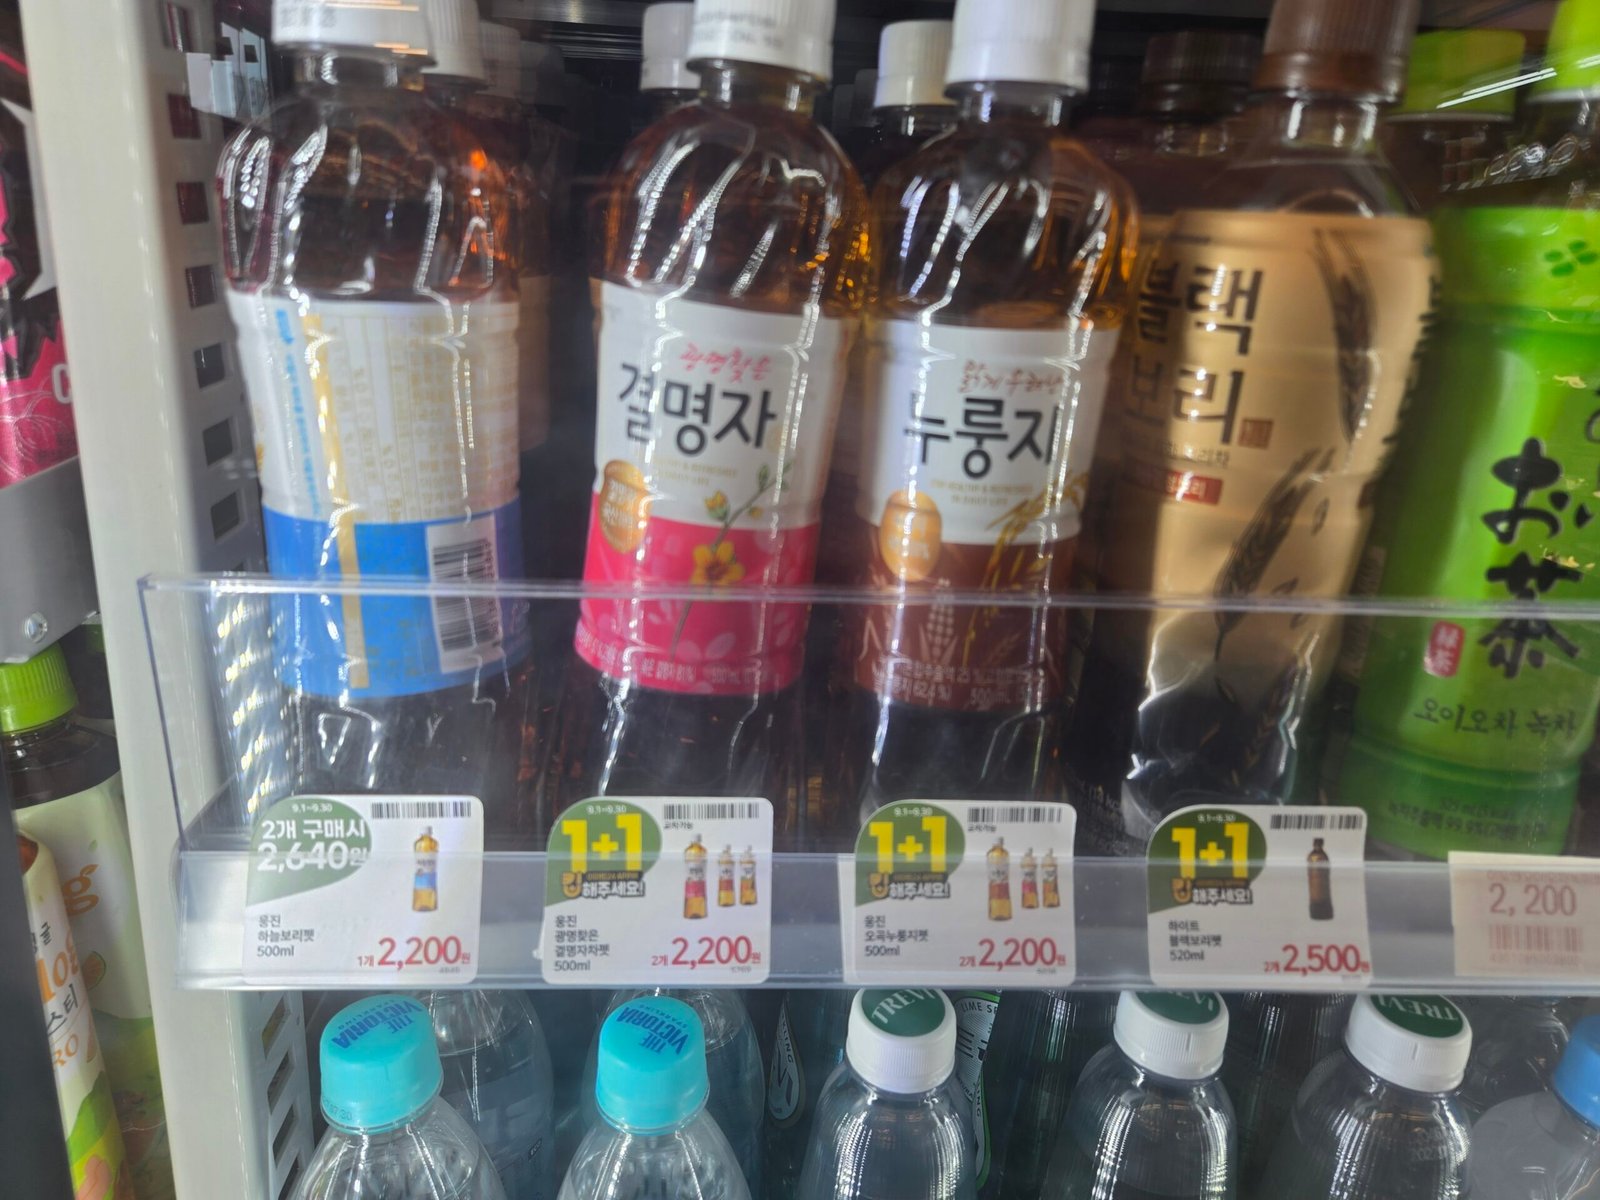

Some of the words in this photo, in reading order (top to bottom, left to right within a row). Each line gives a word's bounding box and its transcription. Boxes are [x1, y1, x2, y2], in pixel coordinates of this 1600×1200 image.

[618, 362, 778, 456] 결명자
[903, 391, 1062, 480] 누룽지
[1414, 697, 1517, 739] 오이오차
[1526, 710, 1577, 738] 녹차
[261, 819, 297, 840] 2개
[303, 818, 366, 840] 구매시
[562, 813, 643, 874] 1+1
[869, 816, 948, 875] 1+1
[1171, 822, 1249, 879] 1+1
[1488, 882, 1578, 917] 2,200
[258, 914, 281, 928] 웅진
[555, 914, 577, 928] 웅진
[864, 914, 887, 928] 웅진
[1168, 920, 1200, 933] 하이트
[257, 928, 315, 943] 하늘보리펫
[555, 929, 600, 943] 광명찾은
[864, 929, 929, 943] 오곡누룽지펫
[257, 945, 295, 957] 500ml
[555, 944, 611, 957] 결명자차펫
[864, 945, 900, 957] 500ml
[1169, 949, 1205, 961] 520ml
[358, 955, 374, 968] 1개
[554, 959, 591, 972] 500ml
[651, 955, 669, 967] 2개
[959, 956, 976, 969] 2개
[1264, 961, 1281, 974] 2개
[961, 1001, 983, 1013] LIME
[331, 1000, 424, 1050] VICTORIA
[385, 1014, 415, 1035] THE
[615, 1006, 689, 1056] VICTORIA
[638, 1032, 667, 1055] THE
